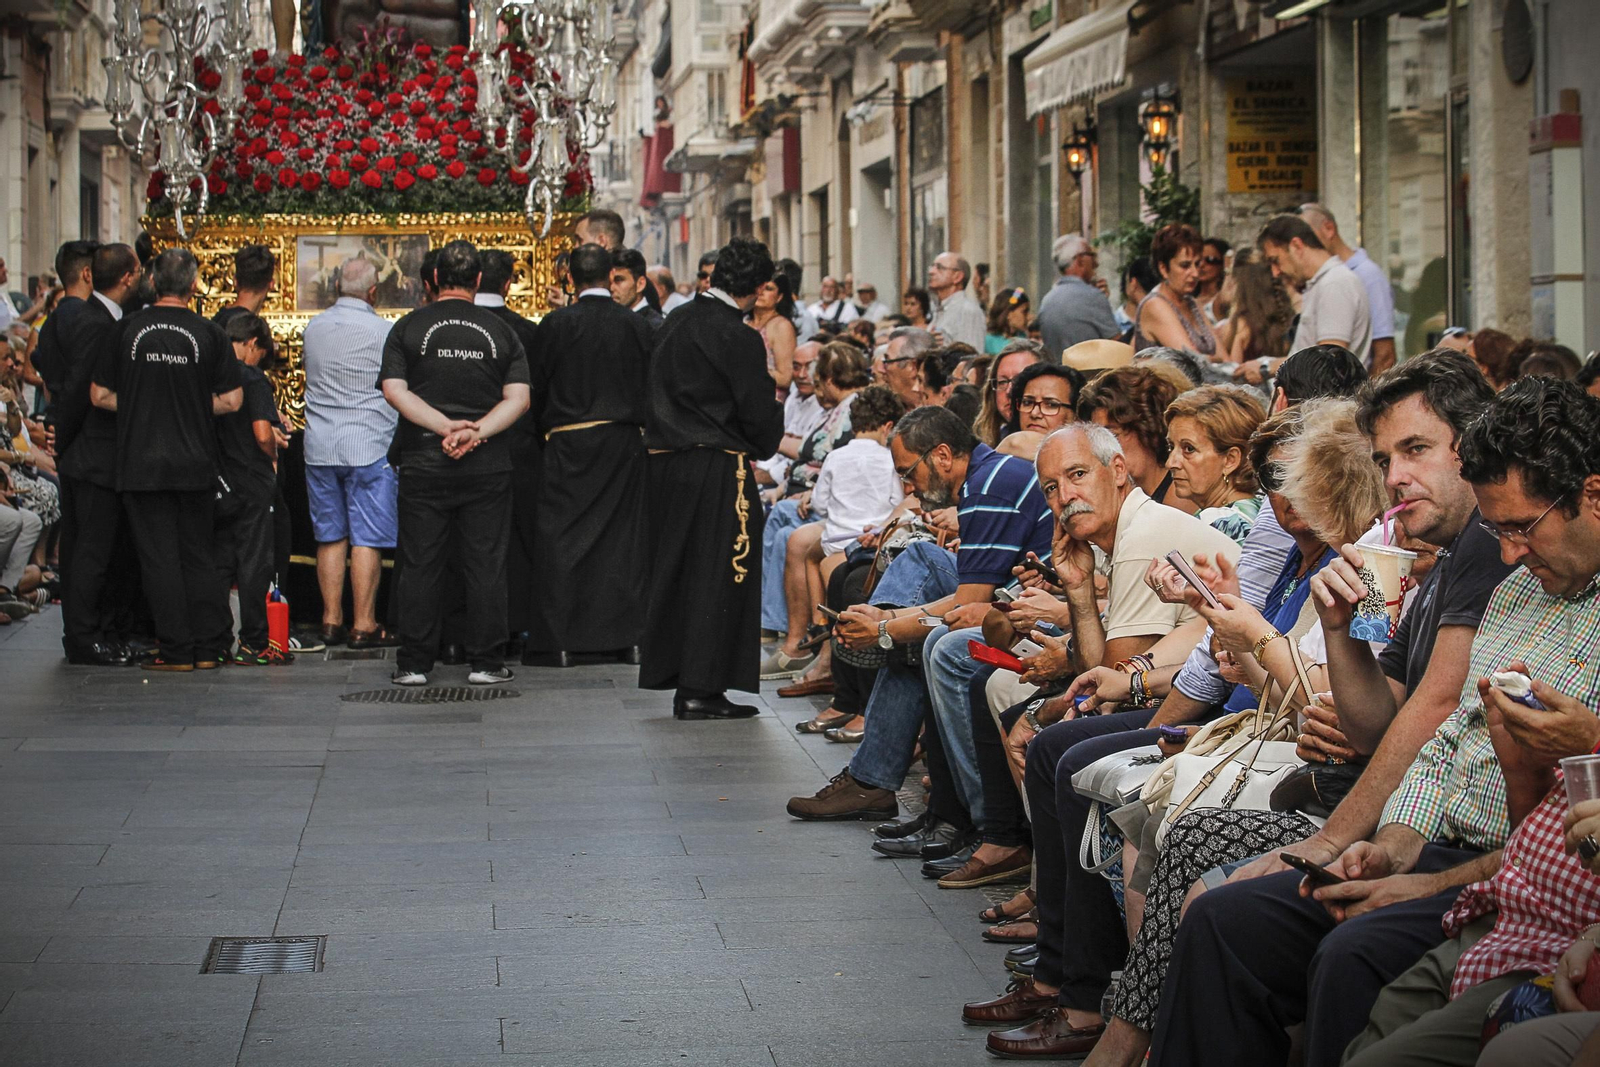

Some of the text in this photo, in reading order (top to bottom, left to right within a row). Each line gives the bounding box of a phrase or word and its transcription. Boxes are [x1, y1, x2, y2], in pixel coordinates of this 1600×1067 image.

[1246, 80, 1294, 92] BAZAR
[1234, 97, 1249, 109] EL
[1228, 141, 1261, 153] BAZAR
[420, 320, 449, 356] CUADRILLA
[146, 353, 188, 365] DEL PAJARO
[437, 349, 484, 360] DEL PAJARO
